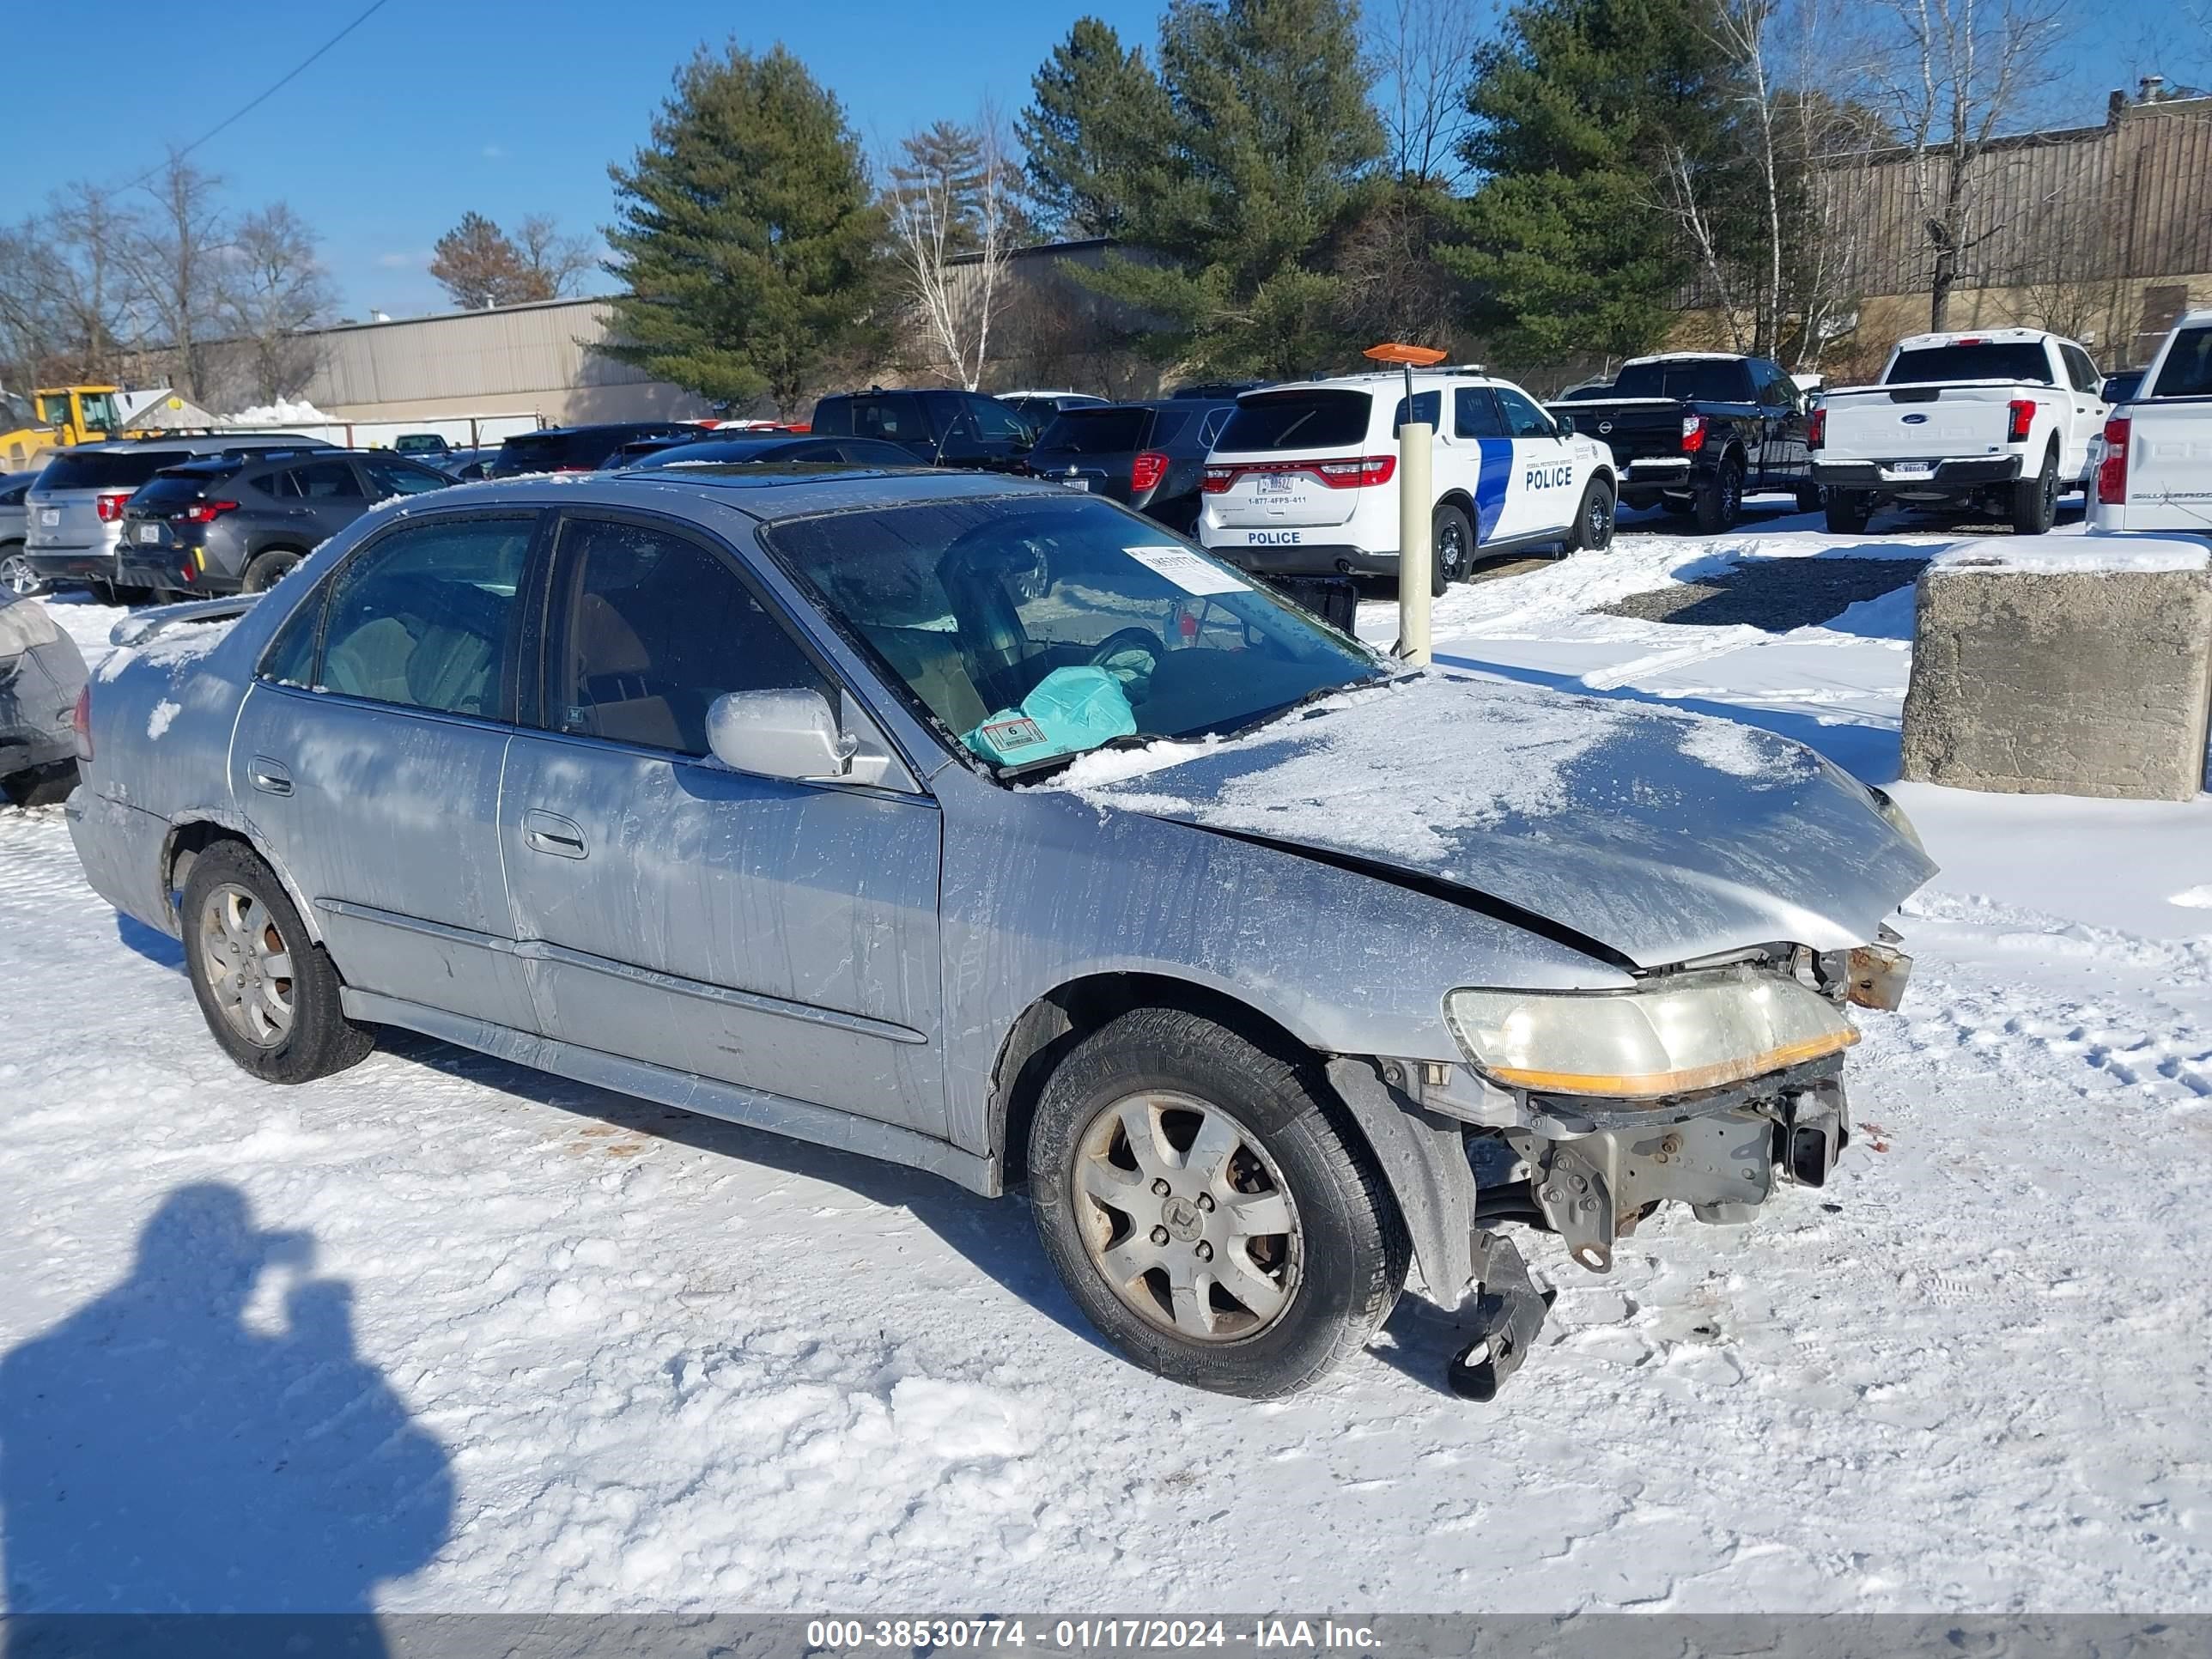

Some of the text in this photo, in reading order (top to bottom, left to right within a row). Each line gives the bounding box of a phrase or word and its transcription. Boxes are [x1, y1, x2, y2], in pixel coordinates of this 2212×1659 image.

[1526, 466, 1572, 492] POLICE
[1248, 496, 1307, 506] 1-877-4FPS-411
[1248, 532, 1302, 544] POLICE
[1008, 726, 1018, 735] 6
